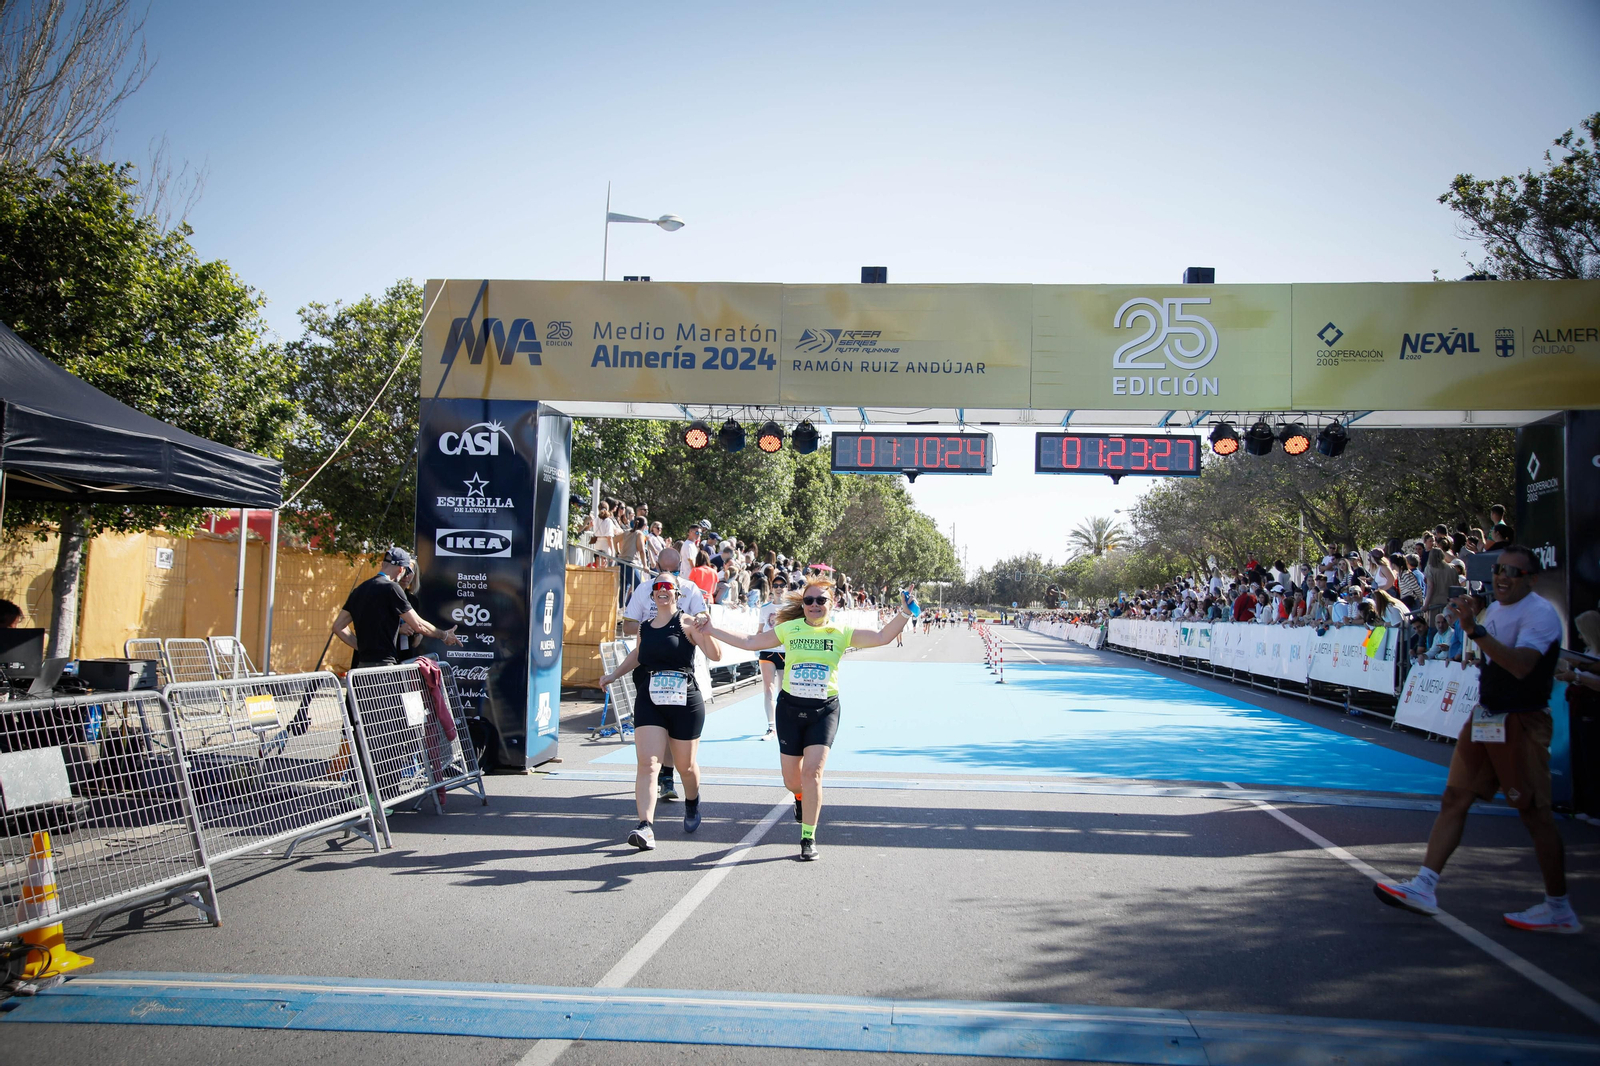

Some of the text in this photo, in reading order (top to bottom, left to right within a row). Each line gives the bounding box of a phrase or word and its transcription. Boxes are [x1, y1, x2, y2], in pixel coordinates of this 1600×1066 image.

[546, 321, 573, 340] 25
[593, 321, 777, 343] Medio Maratón
[1113, 297, 1219, 370] 25
[838, 339, 877, 347] SERIES
[1316, 348, 1384, 358] COOPERACIÓN
[1532, 344, 1576, 355] CIUDAD
[590, 344, 777, 371] Almería 2024
[1316, 358, 1339, 366] 2005
[792, 357, 986, 374] RAMÓN RUIZ ANDÚJAR
[1112, 372, 1219, 396] EDICIÓN
[438, 431, 499, 456] CASI
[1062, 437, 1194, 470] 01:23:27
[436, 496, 515, 508] ESTRELLA
[446, 537, 503, 549] IKEA
[457, 572, 487, 581] Barceló
[456, 581, 488, 589] Cabo de
[456, 589, 475, 597] Gata
[451, 603, 491, 627] ego
[793, 669, 826, 681] 5669
[653, 676, 684, 688] 5057
